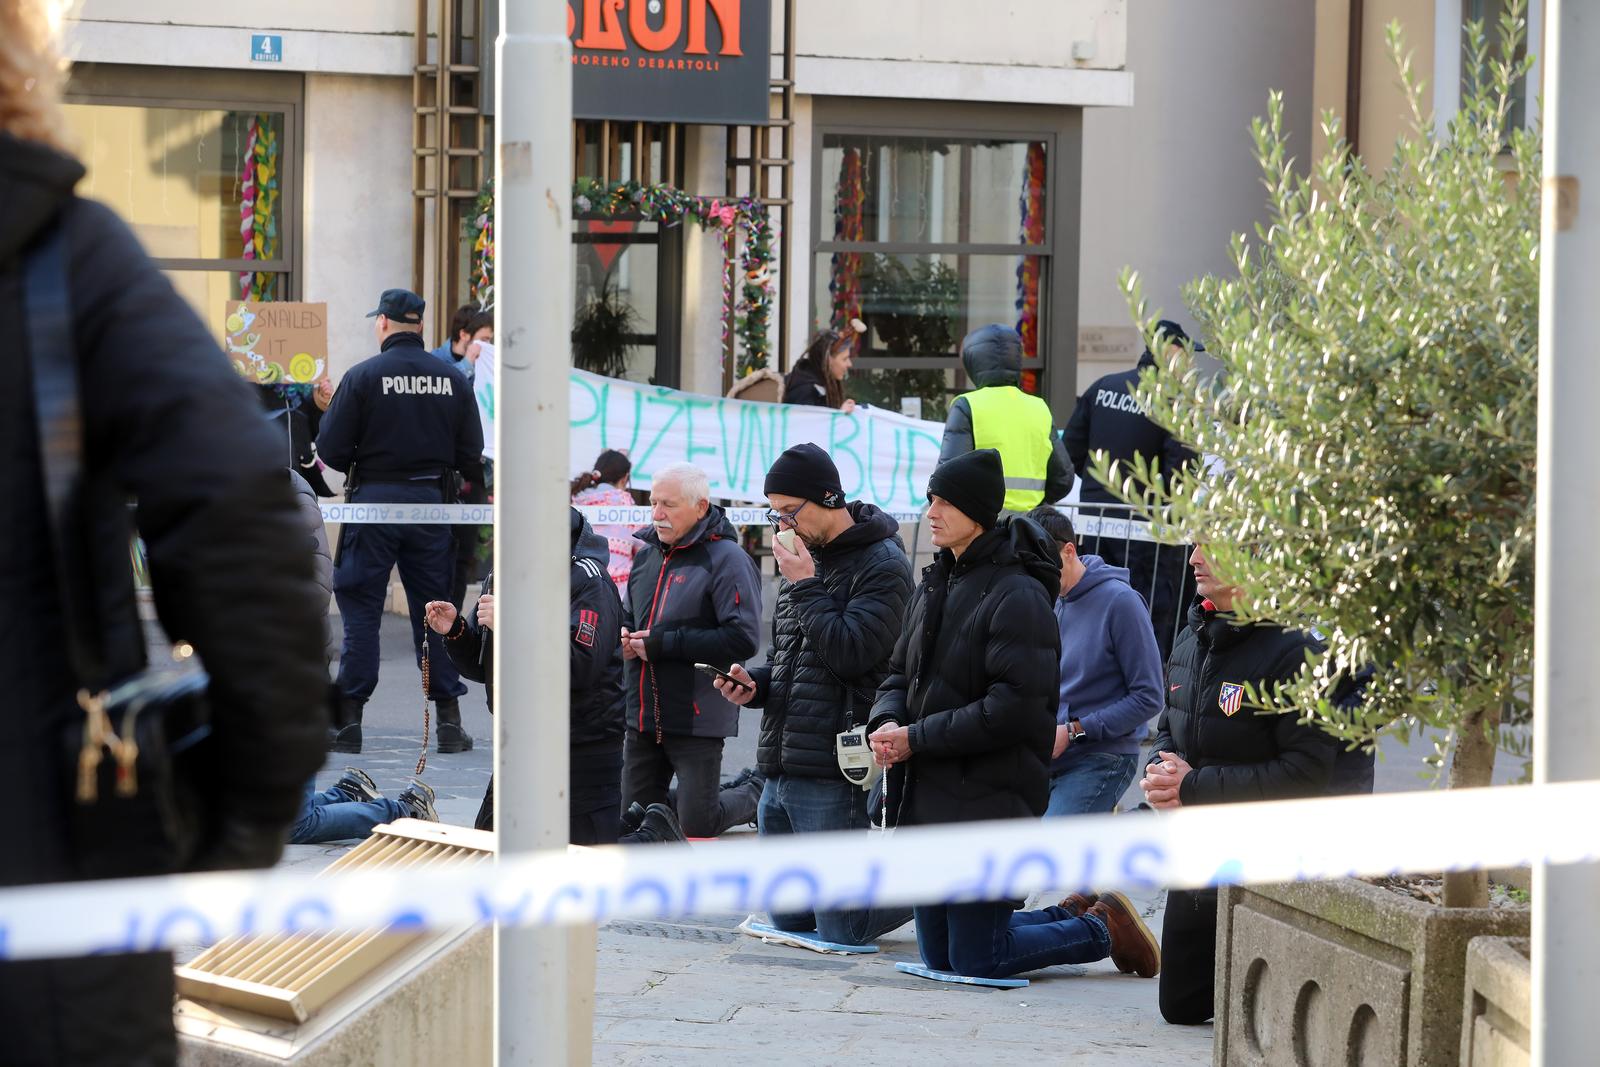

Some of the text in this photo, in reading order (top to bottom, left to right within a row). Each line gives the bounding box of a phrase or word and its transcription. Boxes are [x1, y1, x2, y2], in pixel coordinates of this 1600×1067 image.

[261, 36, 271, 54] 4
[571, 55, 720, 71] MORENO DEBARTOLI
[257, 308, 322, 330] SNAILED
[268, 338, 287, 355] IT
[382, 376, 453, 396] POLICIJA
